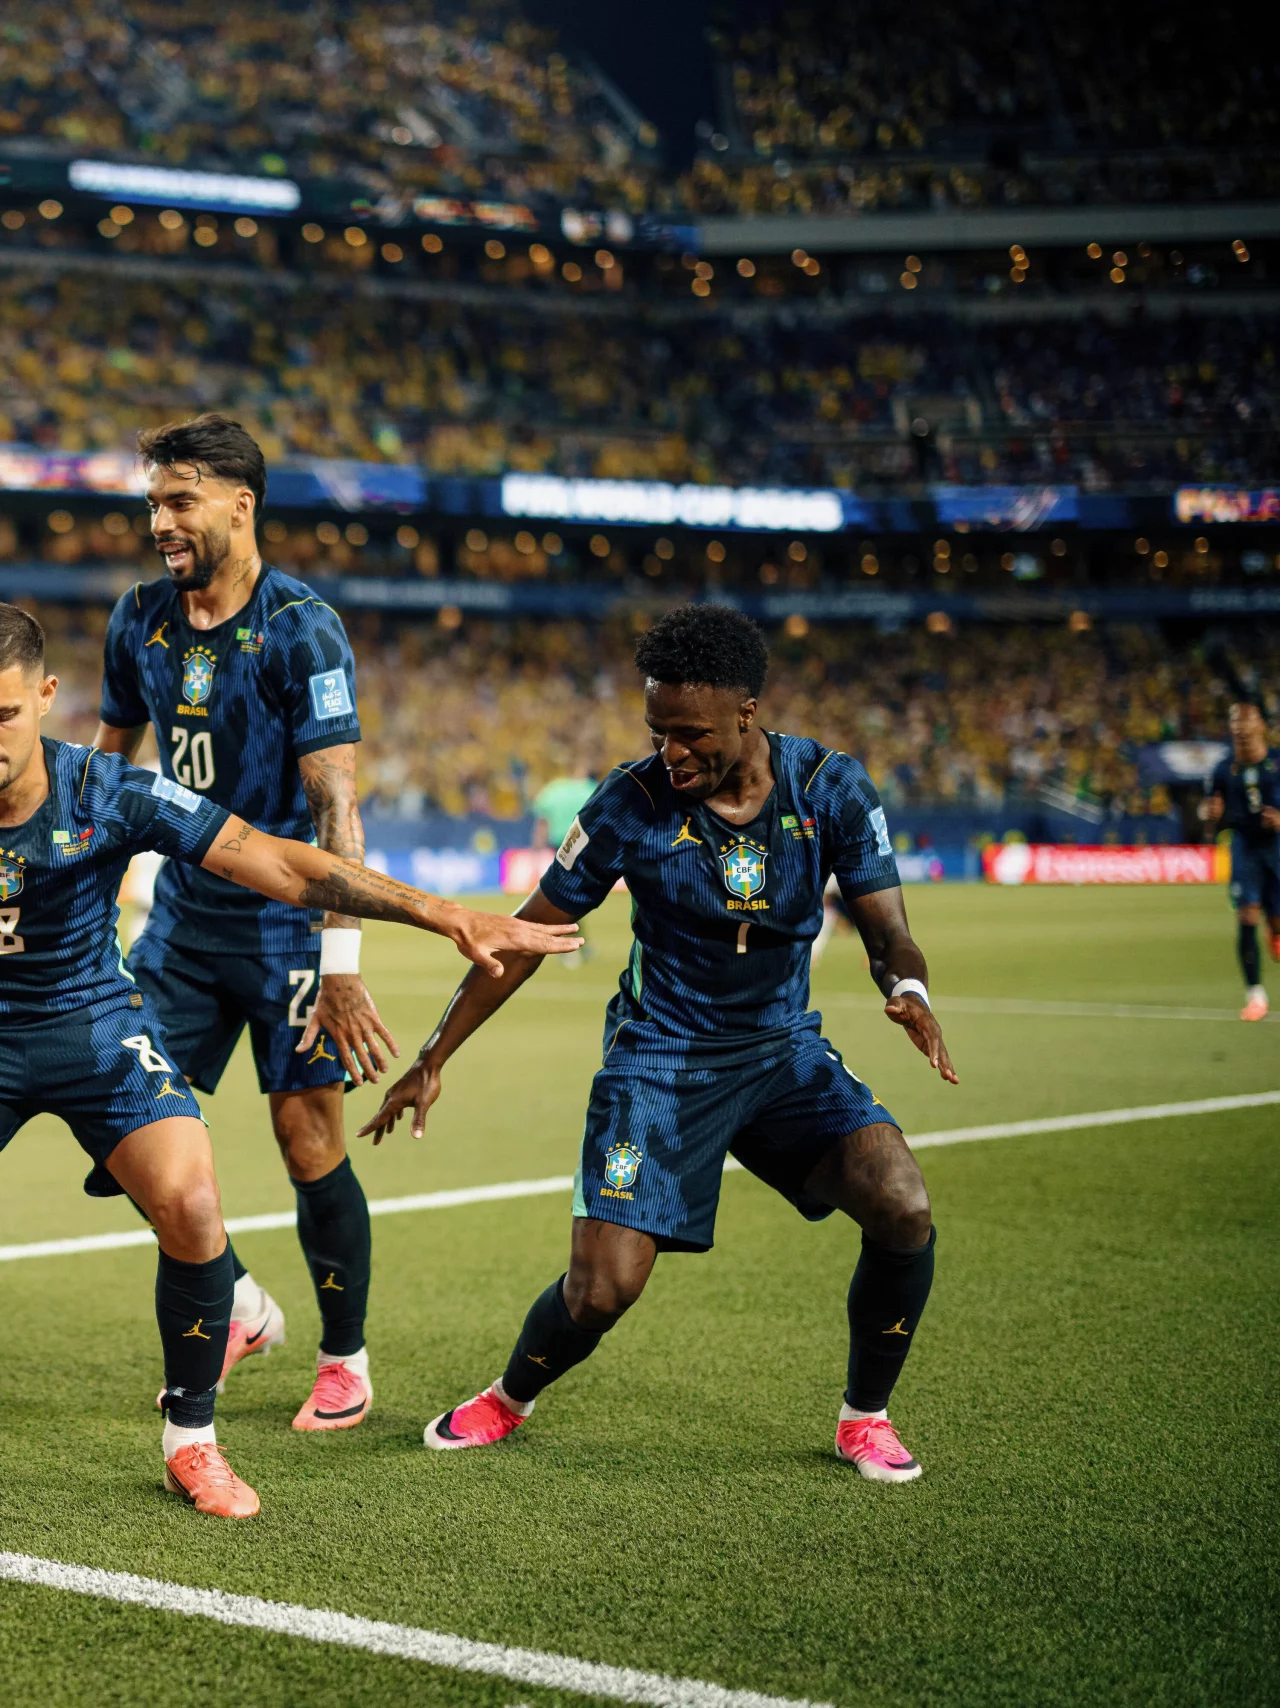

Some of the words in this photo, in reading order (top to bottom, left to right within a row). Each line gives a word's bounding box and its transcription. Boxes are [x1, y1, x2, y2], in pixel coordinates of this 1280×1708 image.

[176, 704, 210, 717] BRASIL
[172, 726, 215, 790] 20
[736, 866, 752, 874] CBF
[726, 899, 770, 911] BRASIL
[120, 1034, 174, 1074] 8
[600, 1188, 635, 1201] BRASIL
